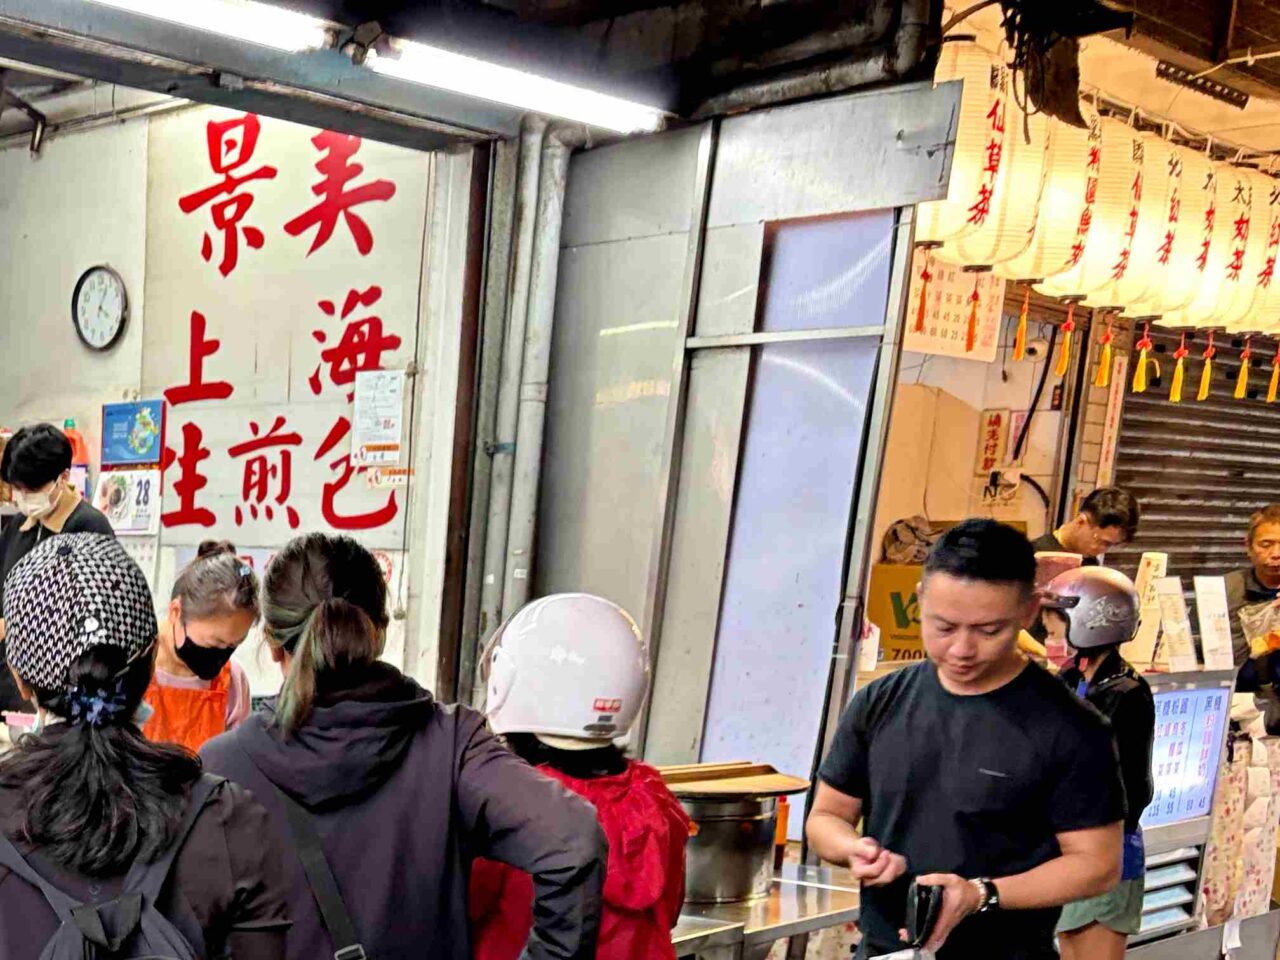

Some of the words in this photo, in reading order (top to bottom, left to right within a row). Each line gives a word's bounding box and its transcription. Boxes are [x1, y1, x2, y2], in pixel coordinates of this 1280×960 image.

[178, 112, 397, 278] 景美
[163, 285, 402, 407] 上海
[135, 478, 150, 506] 28
[160, 415, 399, 530] 生煎包
[891, 648, 927, 661] 700
